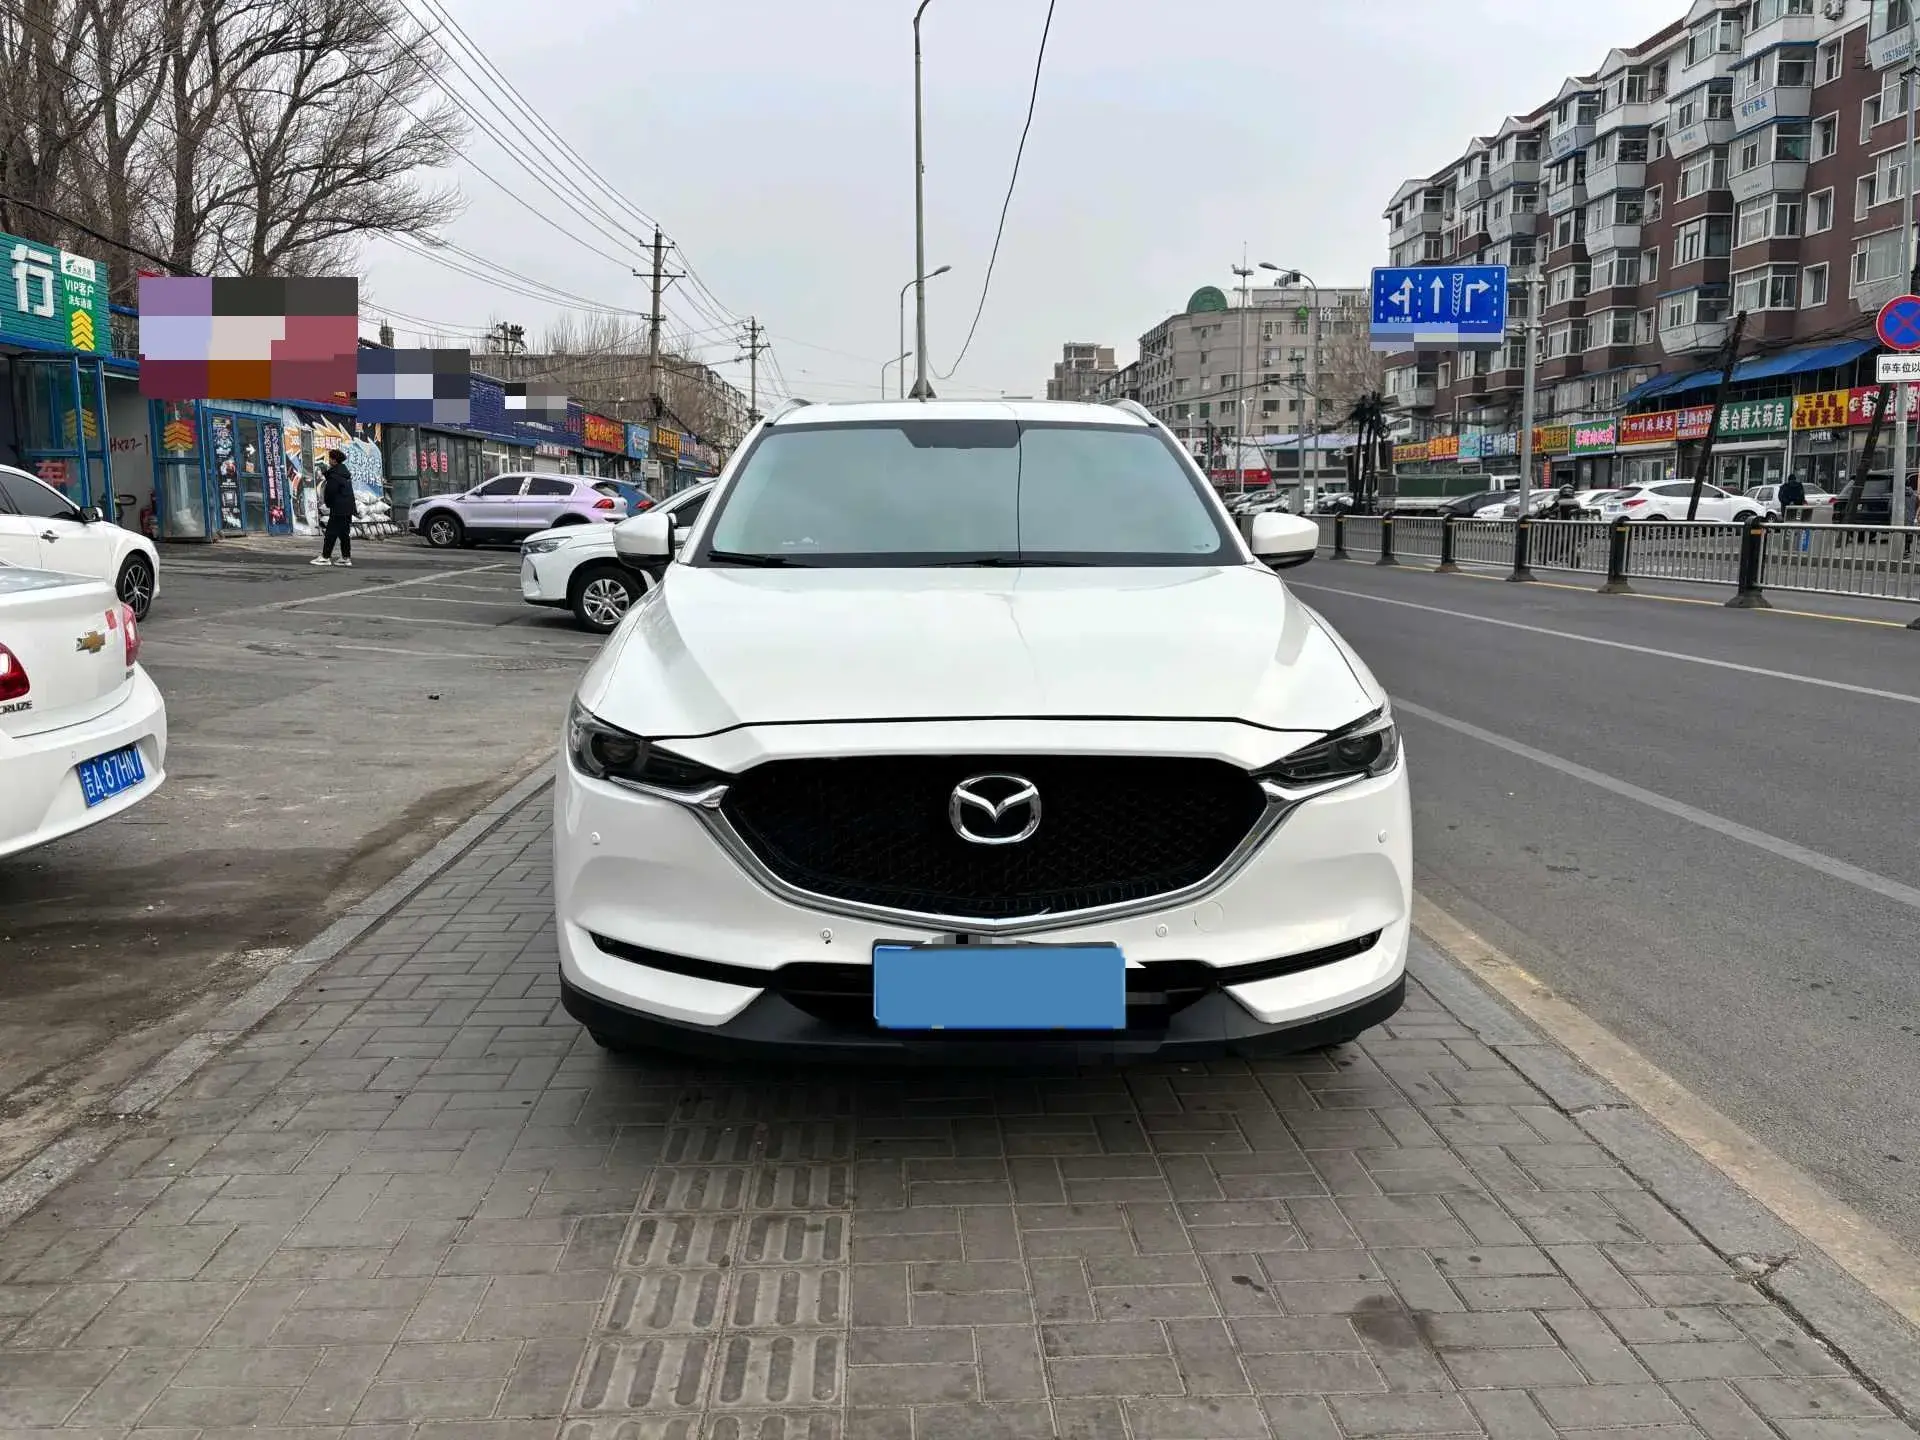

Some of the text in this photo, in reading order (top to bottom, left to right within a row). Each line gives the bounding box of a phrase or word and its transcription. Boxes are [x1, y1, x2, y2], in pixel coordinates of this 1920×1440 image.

[10, 243, 55, 318] 行
[1719, 402, 1785, 432] 泰合康大药房
